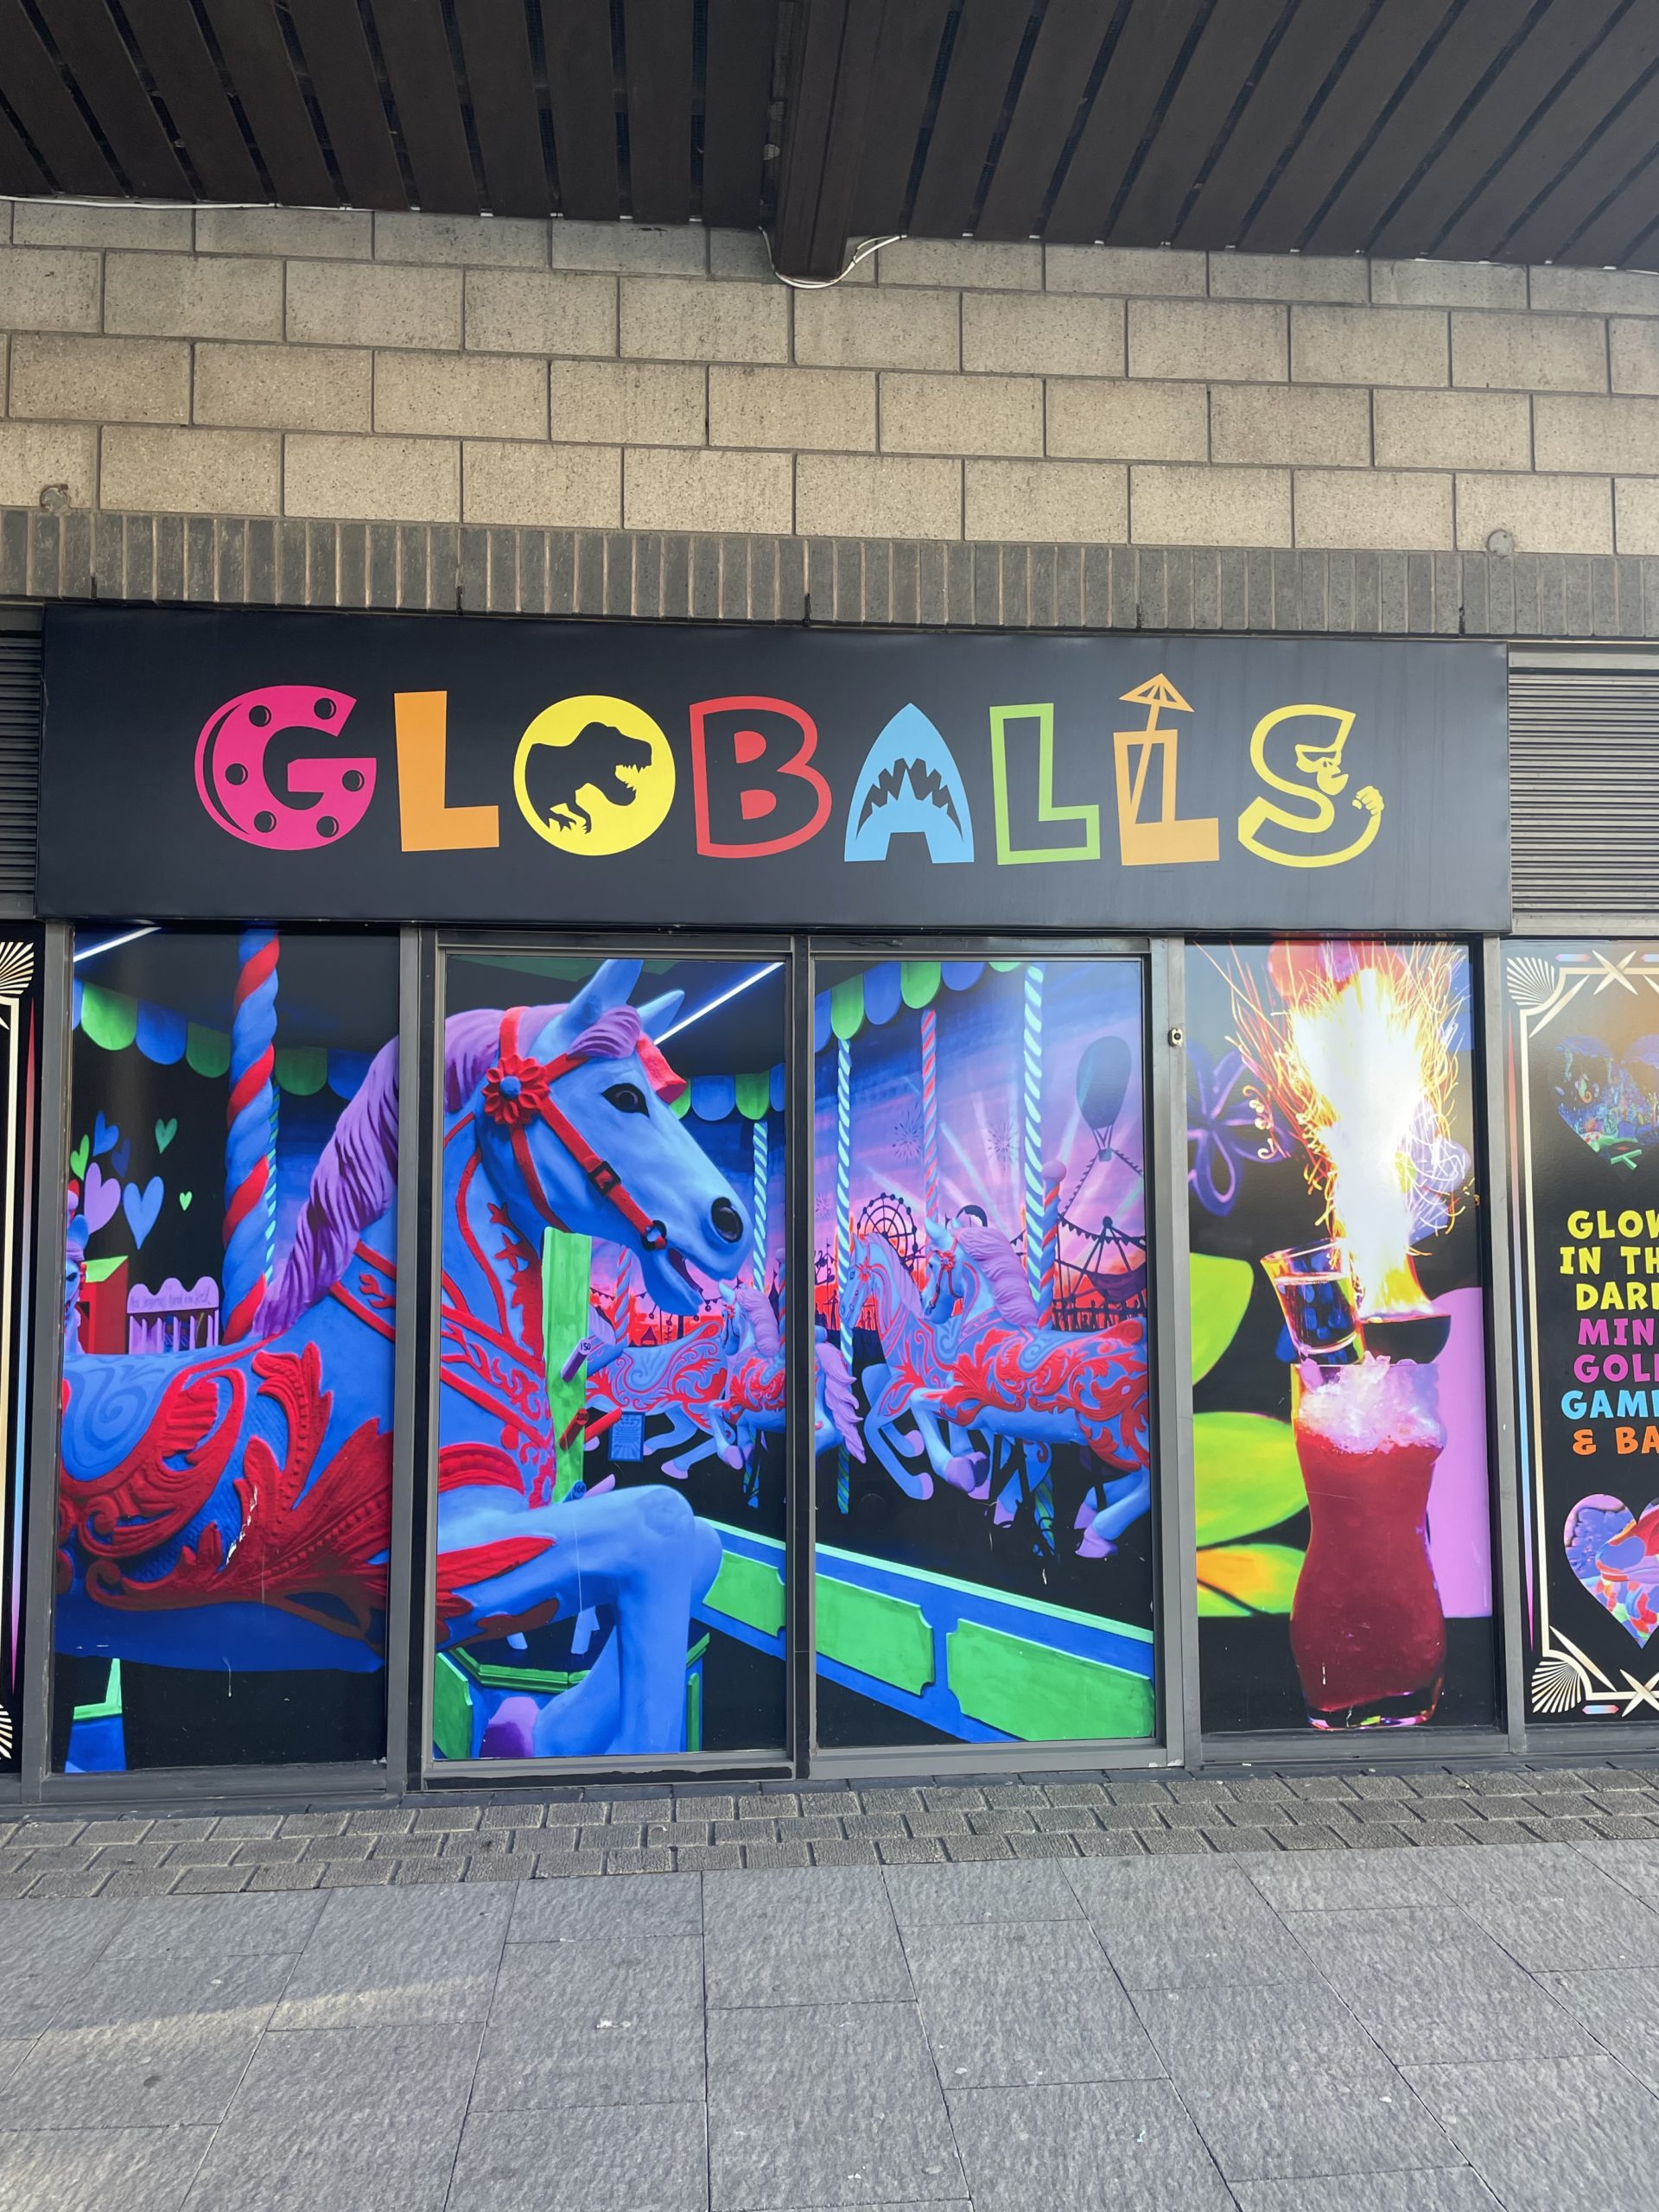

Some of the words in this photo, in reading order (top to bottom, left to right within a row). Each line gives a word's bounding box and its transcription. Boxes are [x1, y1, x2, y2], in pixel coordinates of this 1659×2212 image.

[194, 673, 1385, 868] GLOBALLS
[1560, 1246, 1600, 1274] IN
[1578, 1318, 1659, 1346] MIN
[581, 1342, 591, 1351] 150
[1573, 1353, 1659, 1382] GOL
[1573, 1428, 1597, 1455] &
